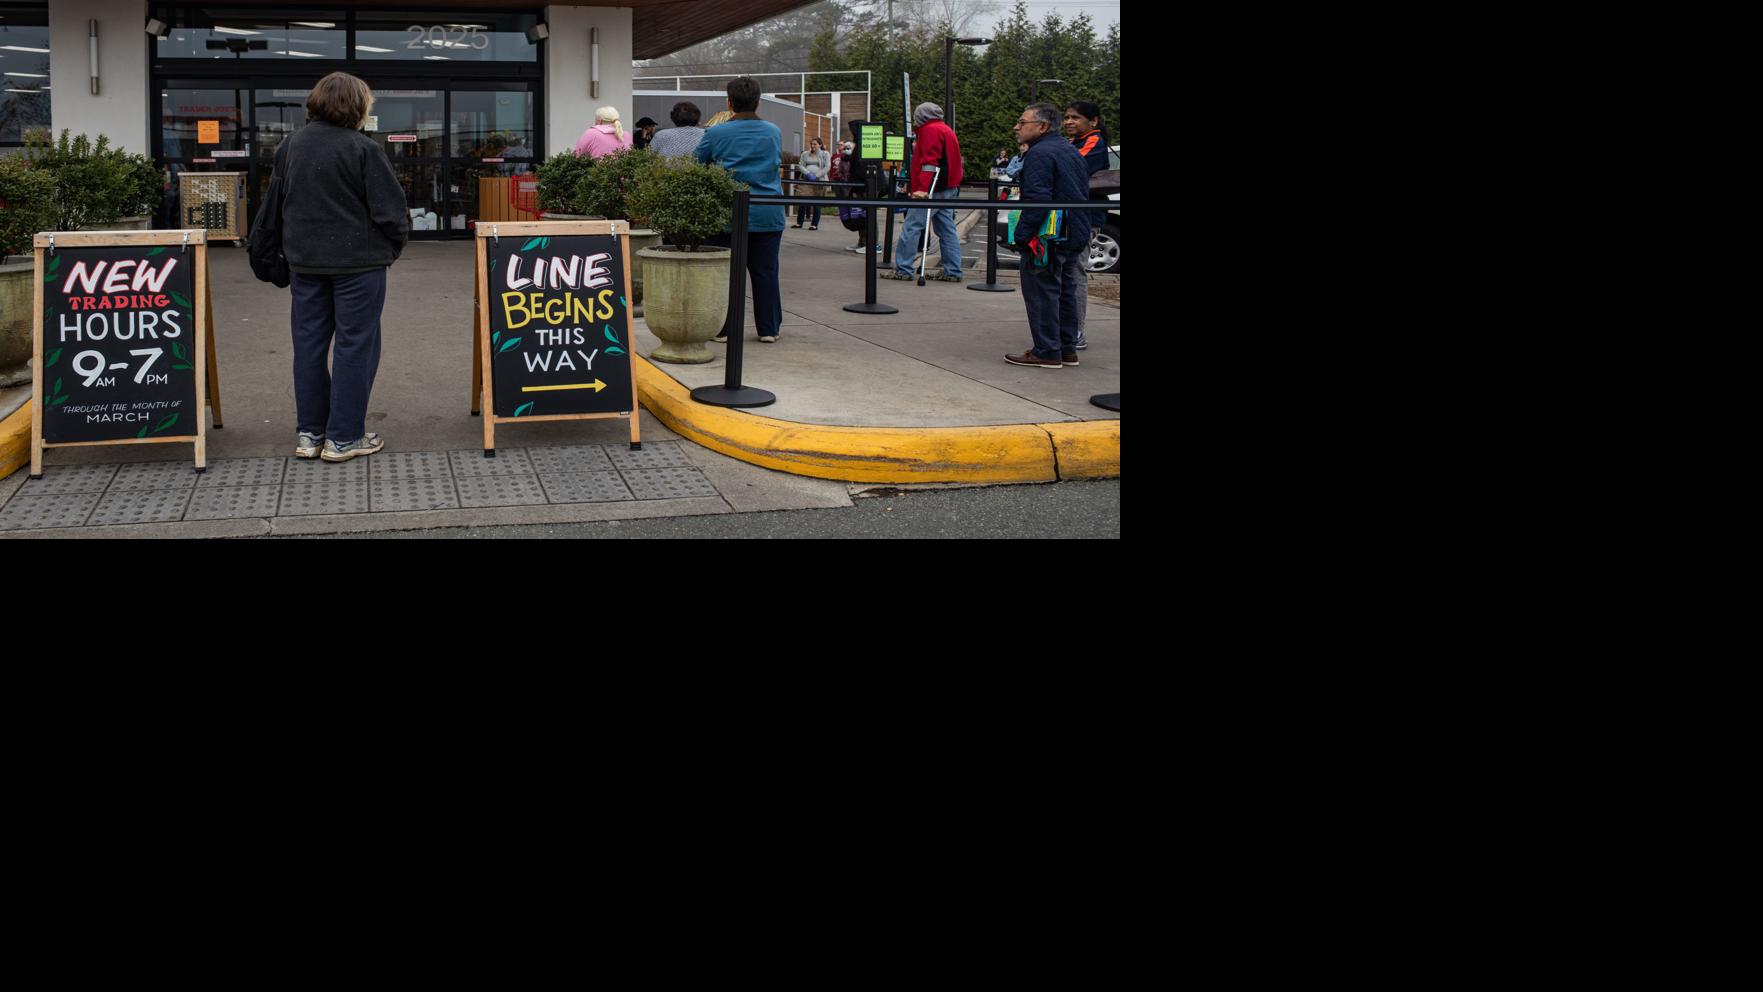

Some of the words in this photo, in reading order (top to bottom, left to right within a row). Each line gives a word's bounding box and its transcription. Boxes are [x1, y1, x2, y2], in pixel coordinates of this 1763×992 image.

[407, 25, 488, 49] 2025
[62, 257, 178, 294] NEW
[506, 252, 614, 291] LINE
[68, 294, 170, 311] TRADING
[501, 289, 614, 329] BEGINS
[59, 309, 181, 342] HOURS
[535, 327, 585, 346] THIS
[523, 348, 598, 373] WAY
[95, 376, 115, 387] AM
[146, 374, 168, 385] PM
[63, 402, 109, 414] THROUGH
[111, 403, 127, 412] THE
[131, 401, 169, 410] MONTH
[170, 400, 182, 408] OF
[87, 411, 150, 424] MARCH
